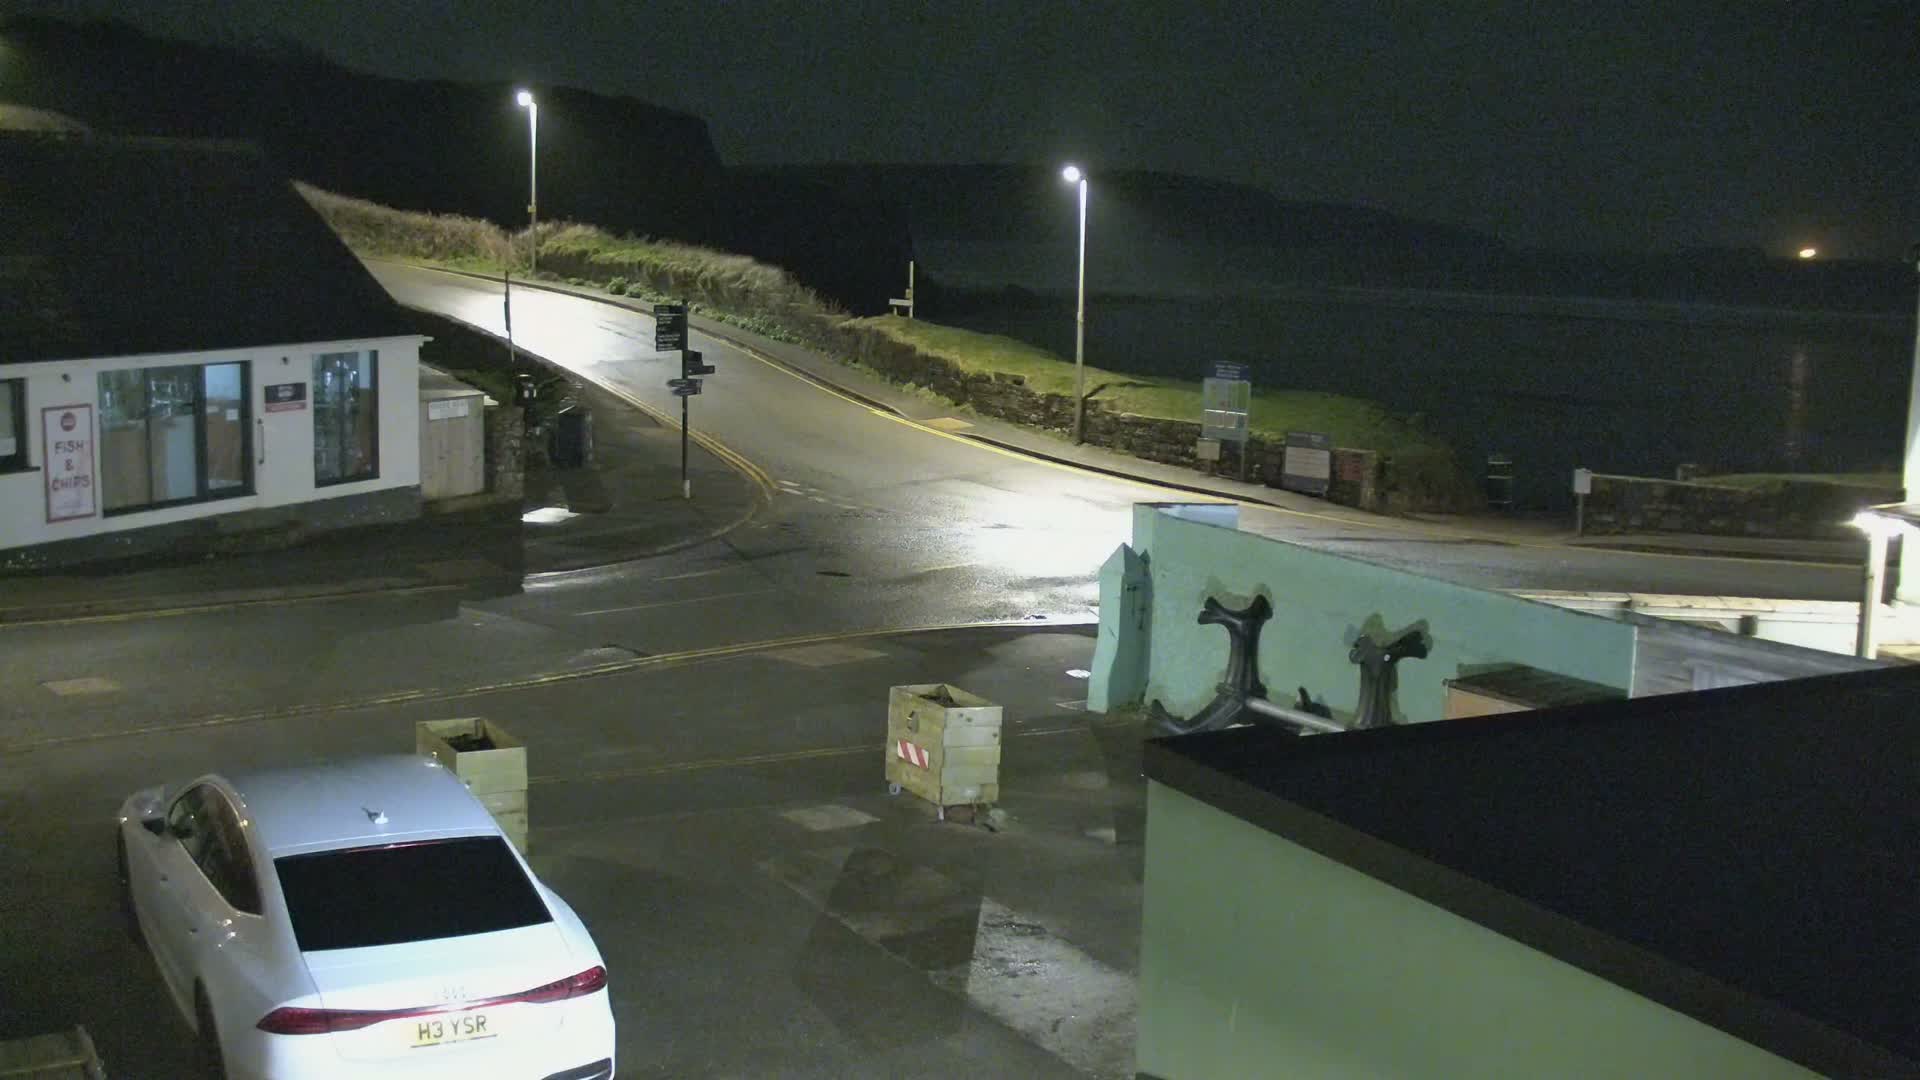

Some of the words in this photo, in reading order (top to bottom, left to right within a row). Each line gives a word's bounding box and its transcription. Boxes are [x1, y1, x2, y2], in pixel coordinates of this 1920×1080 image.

[55, 440, 84, 454] FISH
[65, 459, 74, 471] &
[52, 475, 90, 491] CHIPS
[418, 1021, 443, 1040] H3
[450, 1015, 487, 1035] YSR
